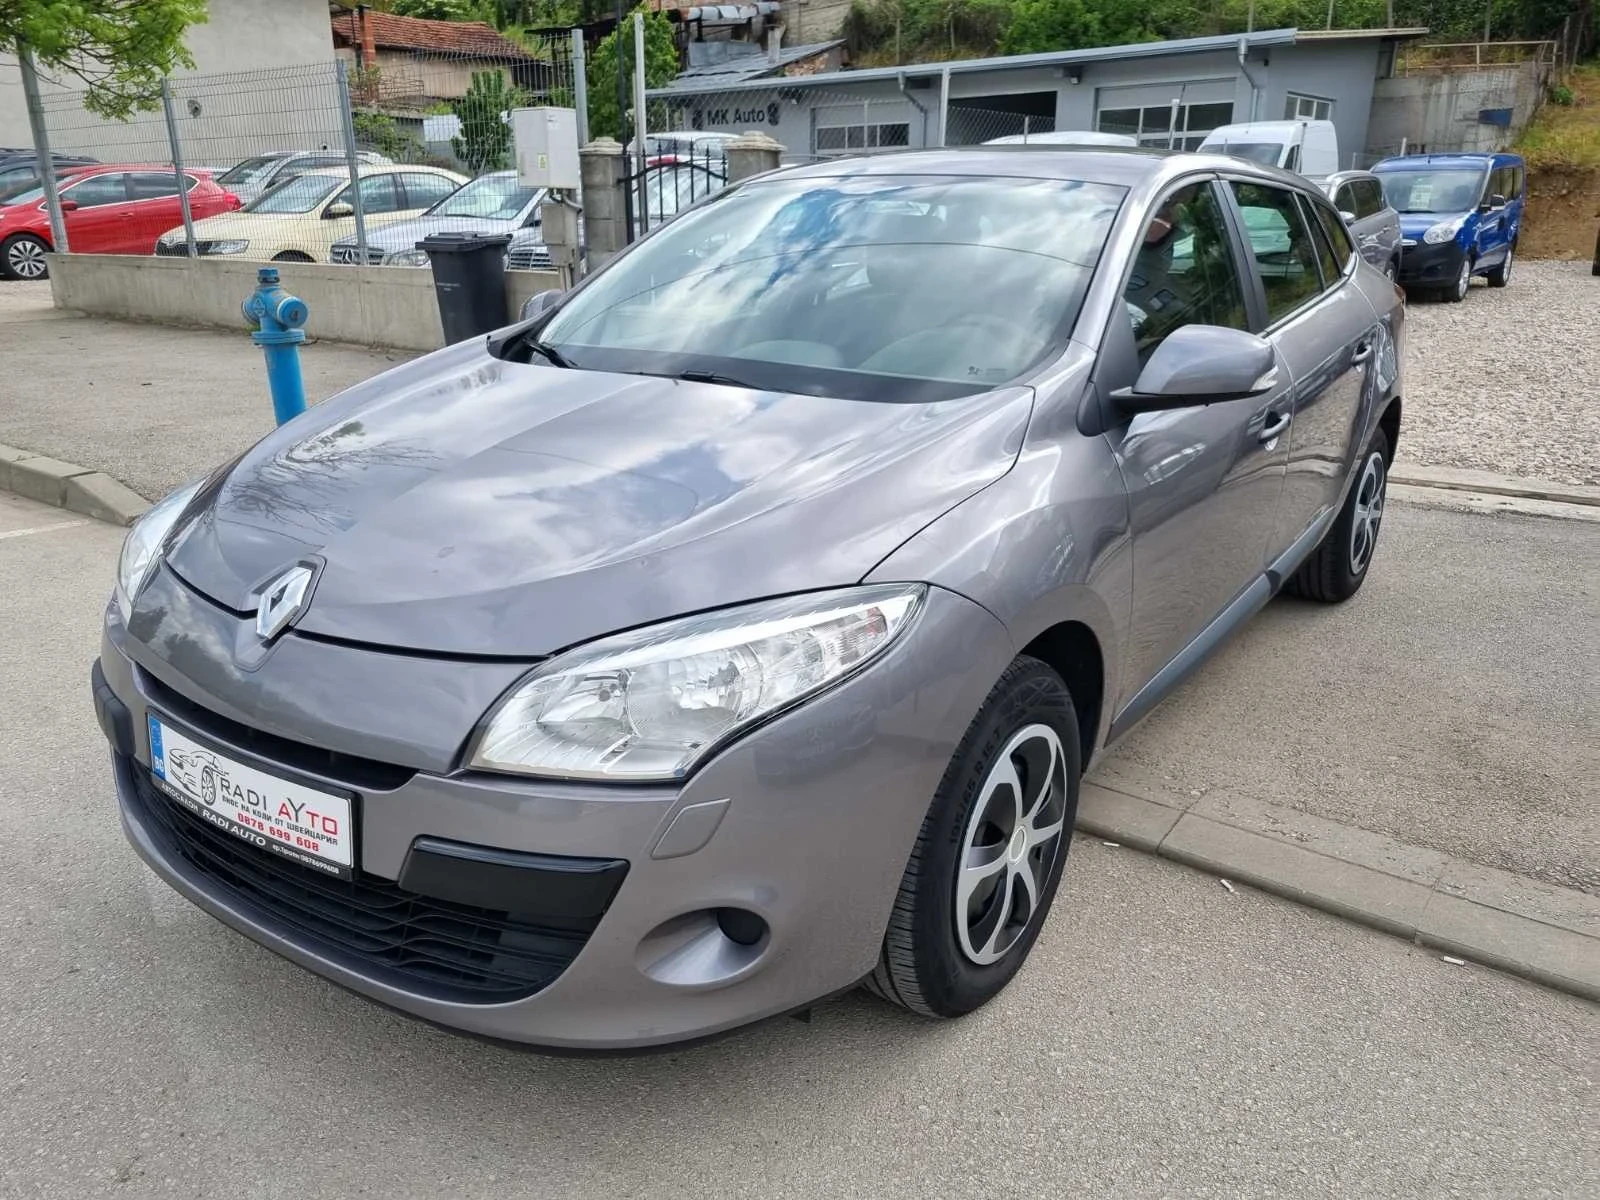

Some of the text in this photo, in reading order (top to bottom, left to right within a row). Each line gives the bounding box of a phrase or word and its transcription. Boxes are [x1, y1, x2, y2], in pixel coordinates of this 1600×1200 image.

[707, 107, 765, 126] MK Auto
[220, 776, 267, 810] RADI
[202, 809, 229, 830] RADI
[231, 825, 266, 847] AUTO
[237, 812, 320, 852] 0878 699 608
[241, 803, 250, 814] НА
[252, 808, 272, 822] КОЛИ
[275, 816, 285, 827] ОТ
[287, 820, 338, 846] ШВЕЙЦАРИЯ
